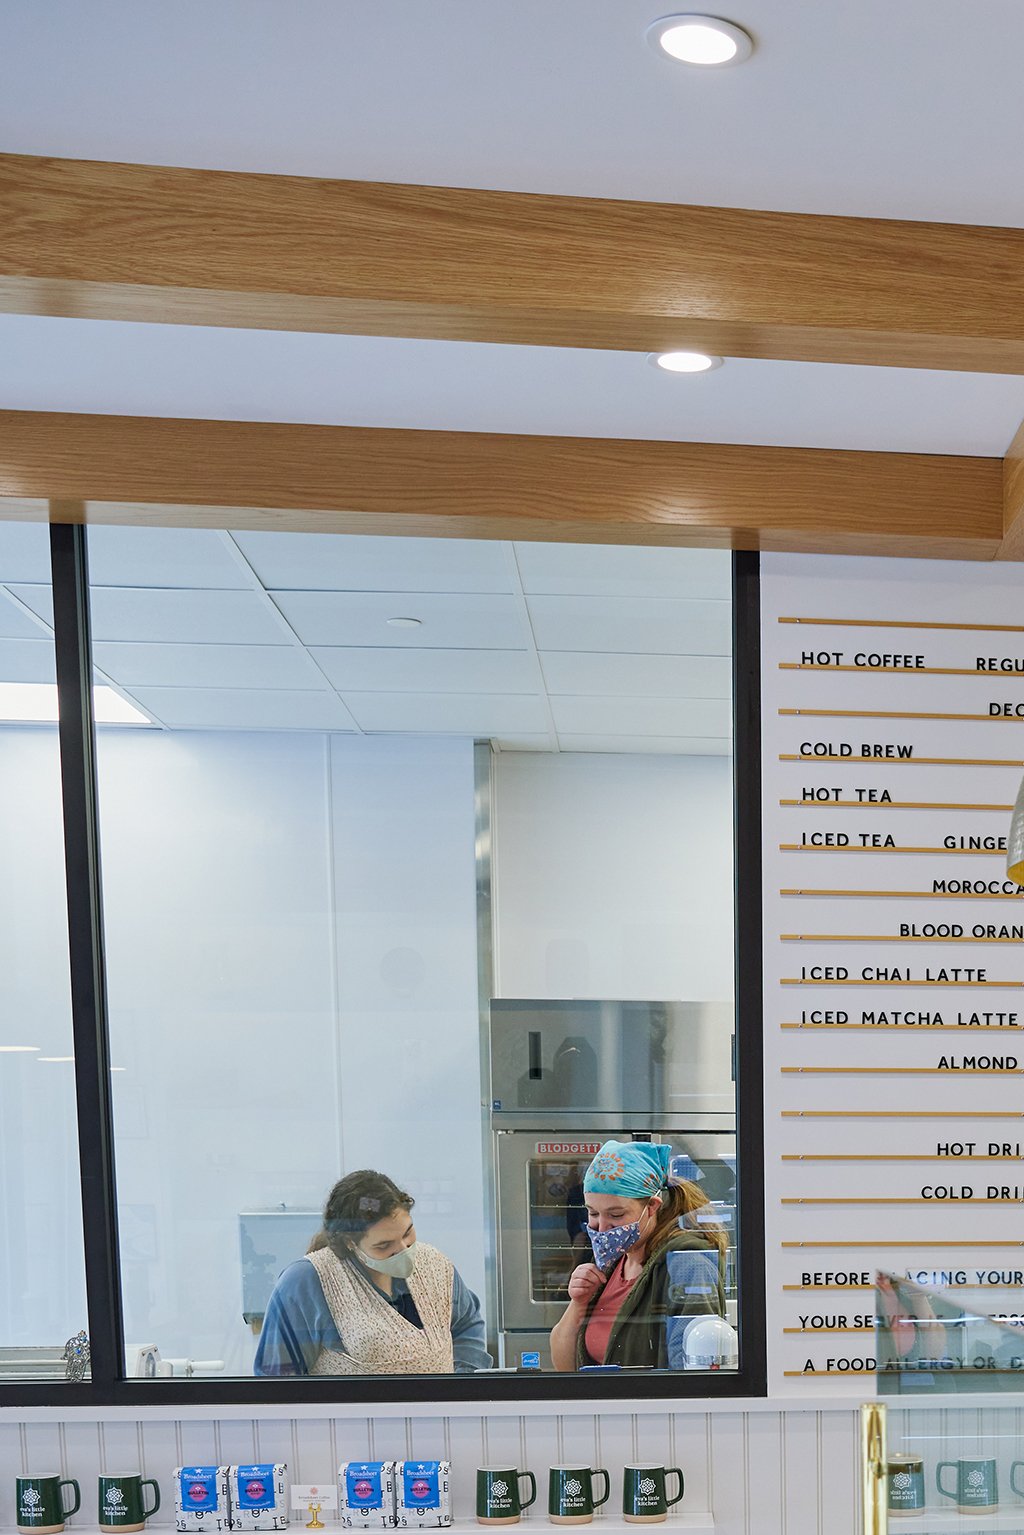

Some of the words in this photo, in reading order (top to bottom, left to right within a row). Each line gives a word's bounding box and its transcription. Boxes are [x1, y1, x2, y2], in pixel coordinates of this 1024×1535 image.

[801, 651, 844, 666] HOT
[854, 652, 926, 669] COFFEE
[799, 742, 853, 757] COLD
[861, 743, 913, 759] BREW
[802, 787, 843, 802] HOT
[854, 788, 892, 803] TEA
[802, 832, 850, 847] ICED
[858, 833, 896, 848] TEA
[943, 835, 1008, 851] GINGE
[900, 923, 964, 938] BLOOD
[802, 966, 849, 981] ICED
[861, 967, 910, 981] CHAI
[926, 968, 987, 983] LATTE
[802, 1011, 849, 1024] ICED
[861, 1011, 944, 1026] MATCHA
[957, 1012, 1018, 1027] LATTE
[937, 1055, 1018, 1070] ALMOND
[540, 1143, 599, 1153] BLODGETT
[937, 1142, 977, 1157] HOT
[920, 1185, 974, 1200] COLD
[801, 1272, 871, 1286] BEFORE
[890, 1271, 967, 1285] ACING
[976, 1270, 1024, 1285] YOUR
[799, 1315, 848, 1328] YOUR
[803, 1358, 816, 1372] A
[827, 1358, 877, 1371] FOOD
[885, 1357, 964, 1370] ALLERGY
[973, 1357, 997, 1369] OR
